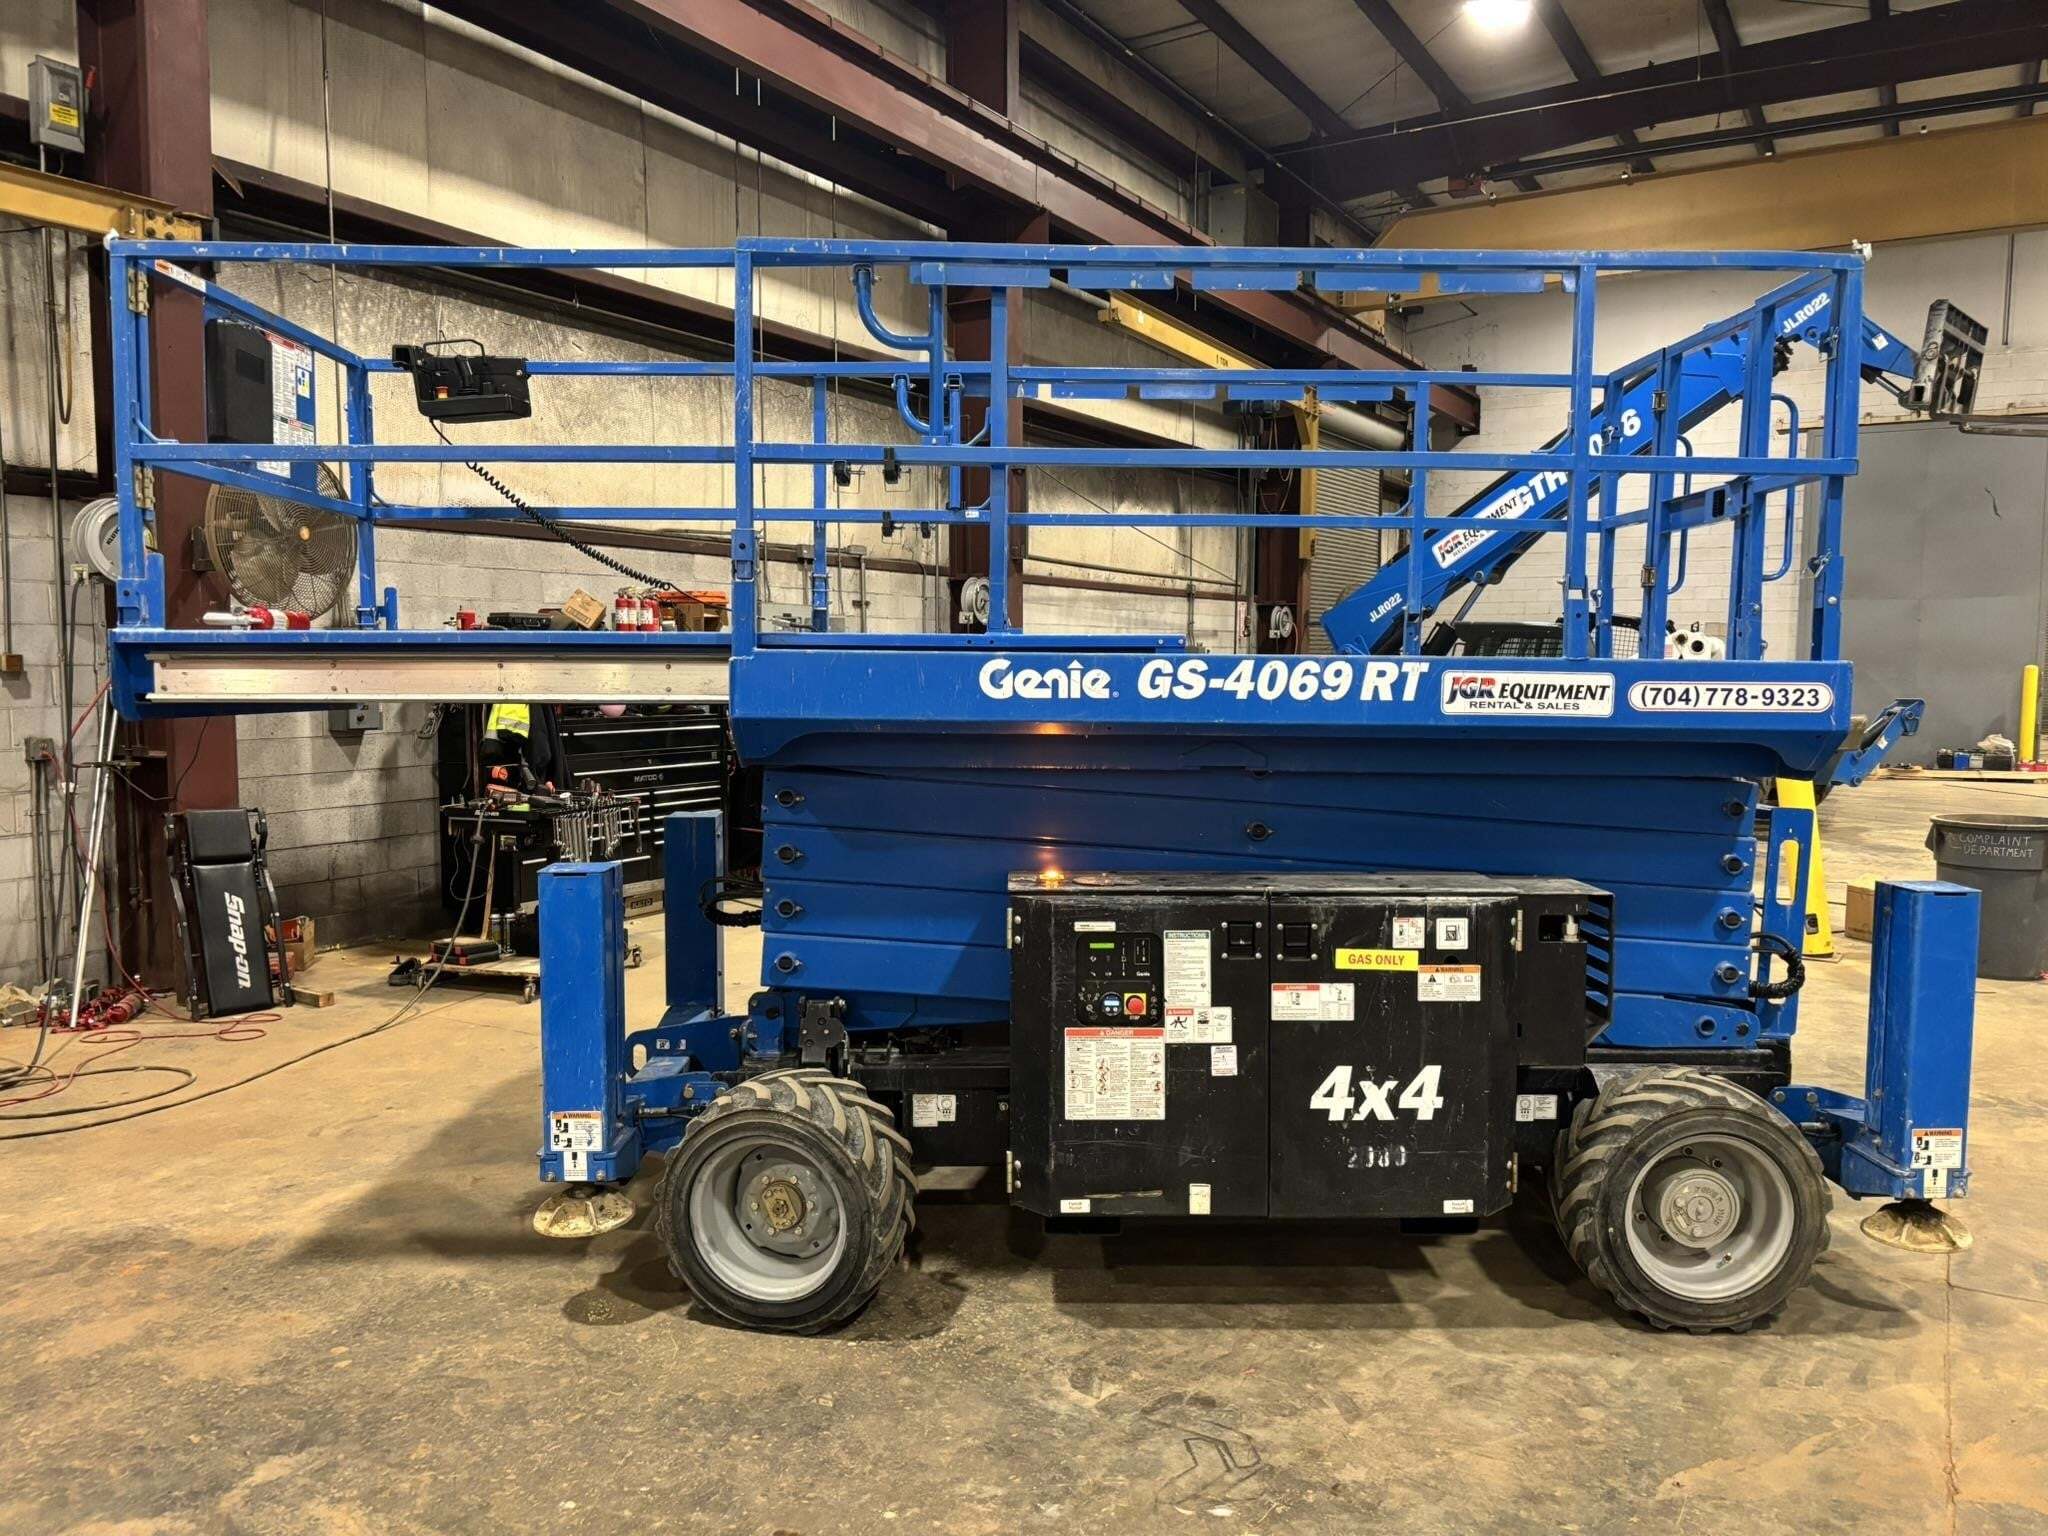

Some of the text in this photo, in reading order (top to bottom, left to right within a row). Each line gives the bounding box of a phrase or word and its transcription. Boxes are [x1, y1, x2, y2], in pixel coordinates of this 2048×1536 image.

[1783, 292, 1831, 334] JLR022
[979, 658, 1430, 702] Genie GS-4069 RT
[1499, 684, 1610, 702] EQUIPMENT
[1640, 686, 1821, 709] (704) 778-9323
[1469, 701, 1580, 710] RENTAL & SALES
[1959, 833, 2032, 847] COMPLAINT
[1963, 845, 2034, 858] DEPARTMENT
[1348, 954, 1405, 966] GAS ONLY
[1309, 1064, 1445, 1122] 4x4
